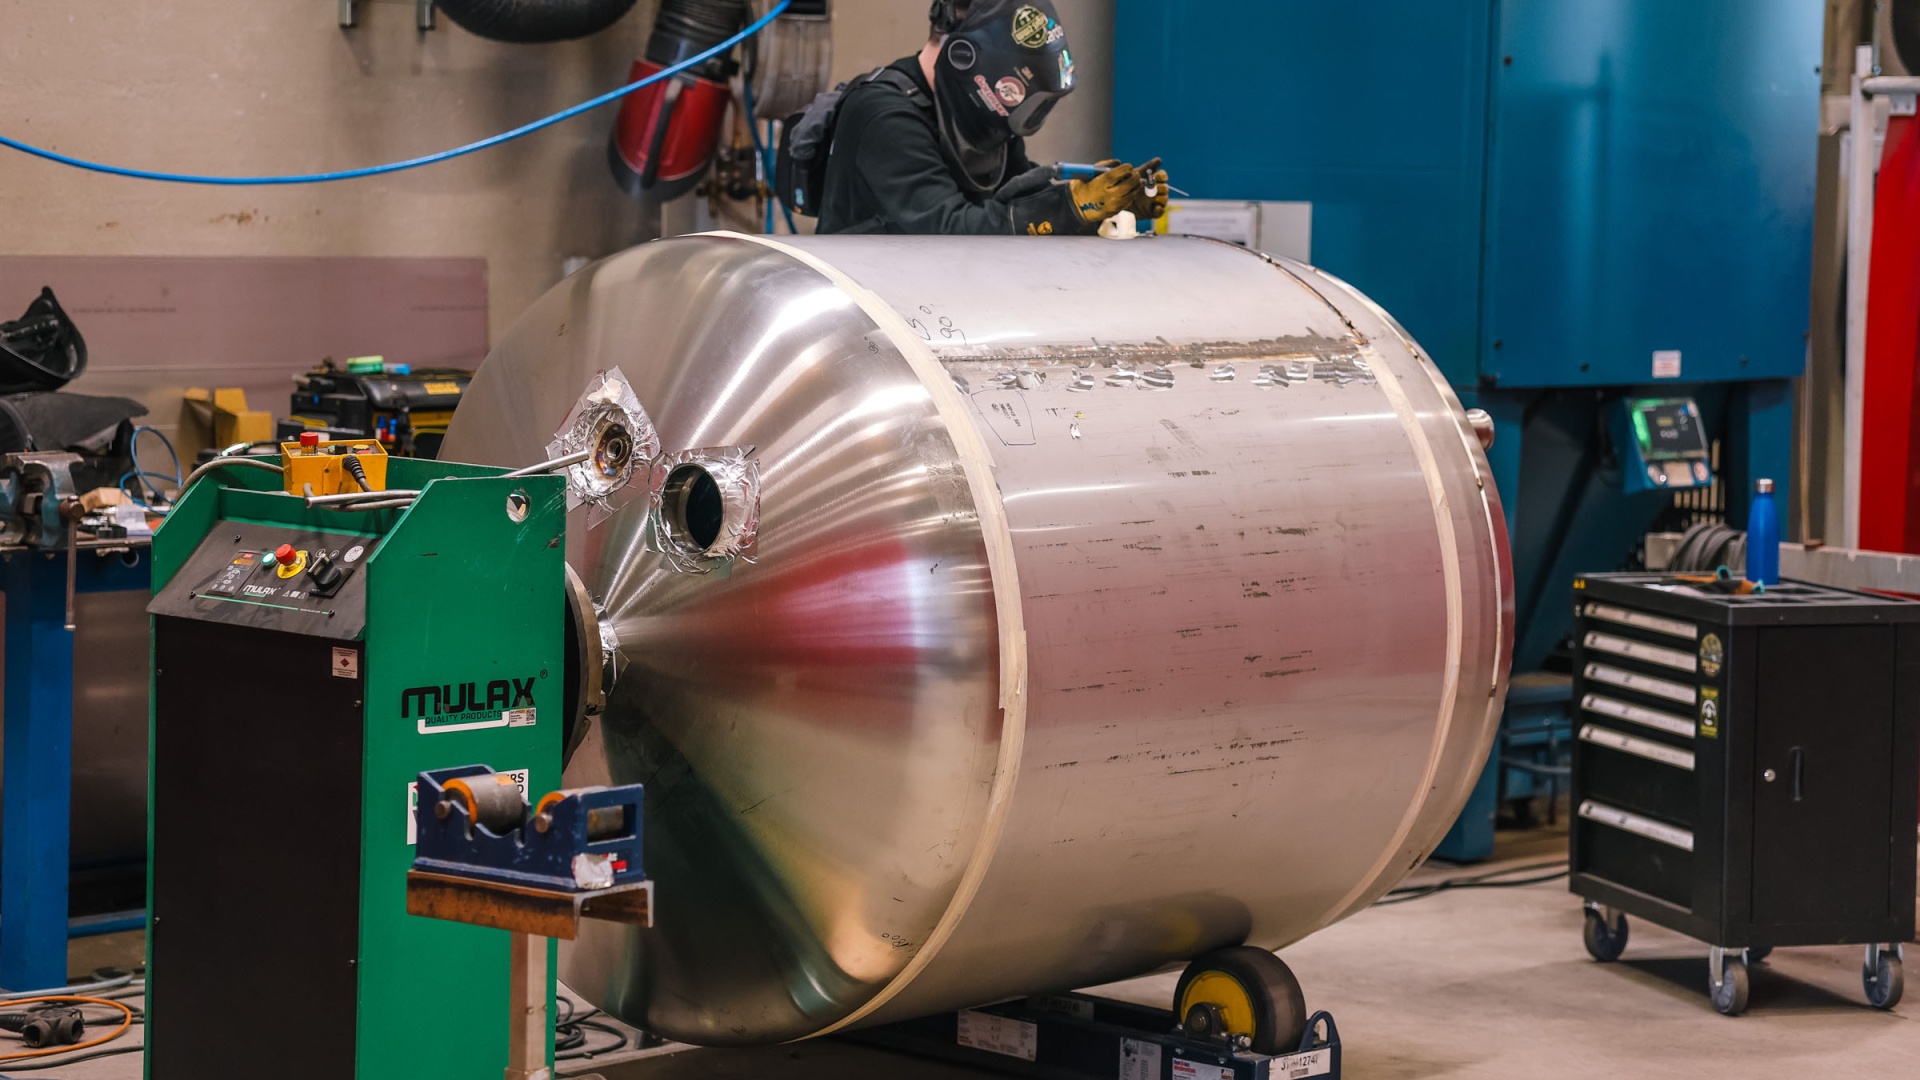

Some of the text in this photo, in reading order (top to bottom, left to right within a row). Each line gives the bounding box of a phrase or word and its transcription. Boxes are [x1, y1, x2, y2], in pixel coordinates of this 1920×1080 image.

[243, 584, 277, 596] MULAX
[401, 677, 536, 719] MULAX
[460, 710, 502, 721] PRODUCTS
